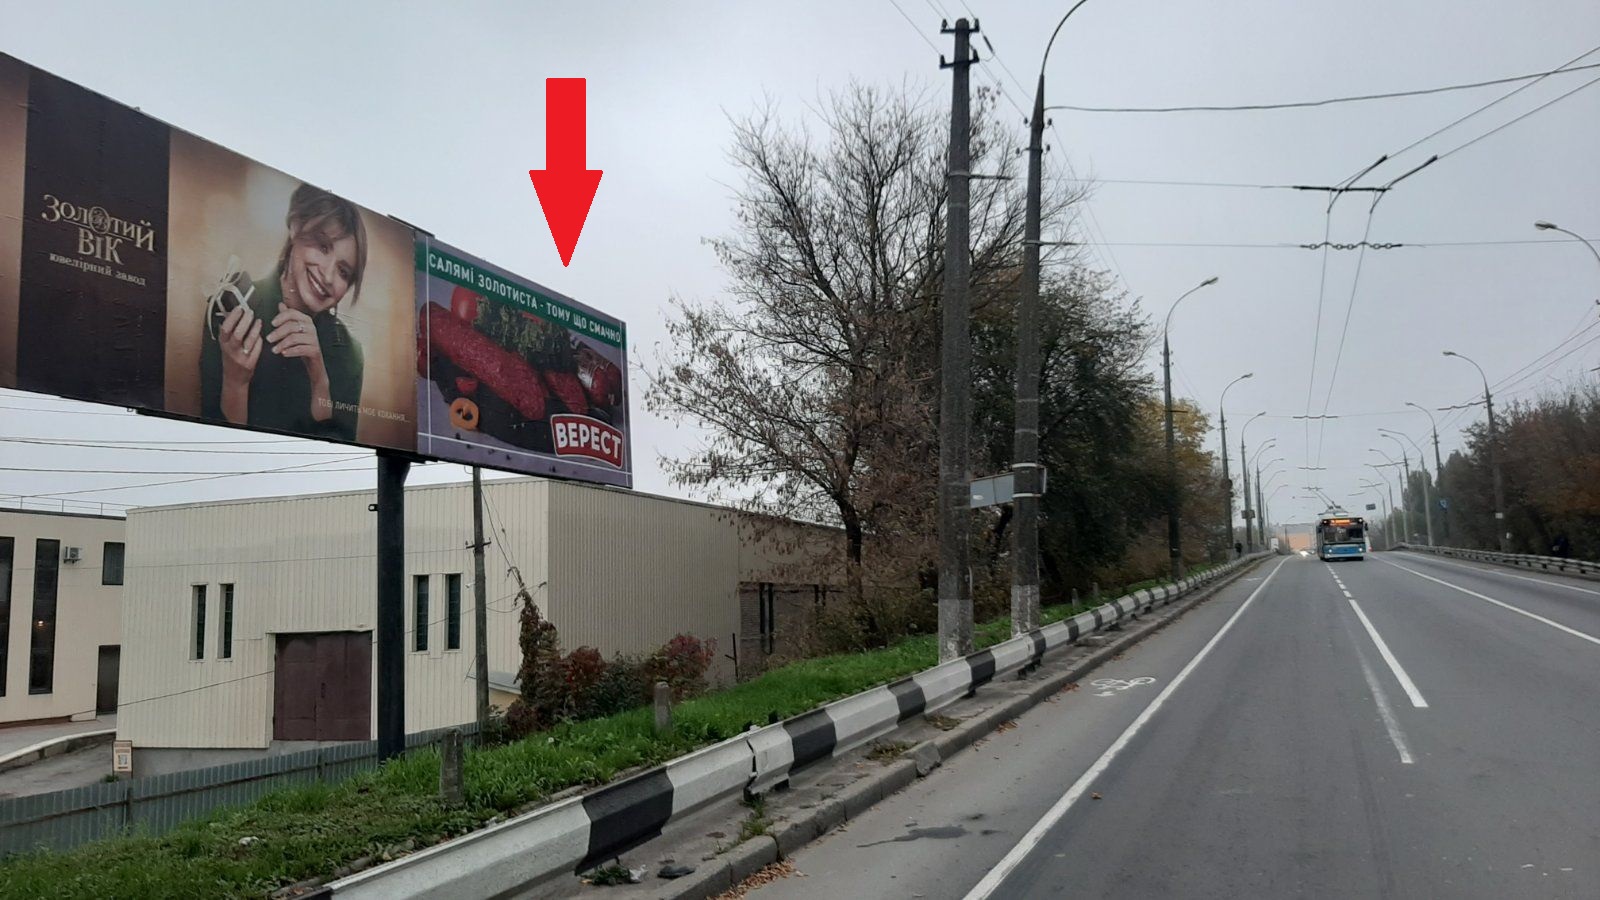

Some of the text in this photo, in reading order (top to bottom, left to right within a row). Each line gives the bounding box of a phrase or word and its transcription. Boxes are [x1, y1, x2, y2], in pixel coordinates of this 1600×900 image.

[78, 227, 125, 265] ВІК
[49, 252, 146, 286] ювелірний завод
[478, 274, 538, 310] ЗОЛОТИСТА
[546, 302, 570, 322] ТОМУ
[573, 314, 587, 329] ЩО
[589, 321, 621, 343] СМАЧНО
[555, 422, 622, 459] ВЕРЕСТ
